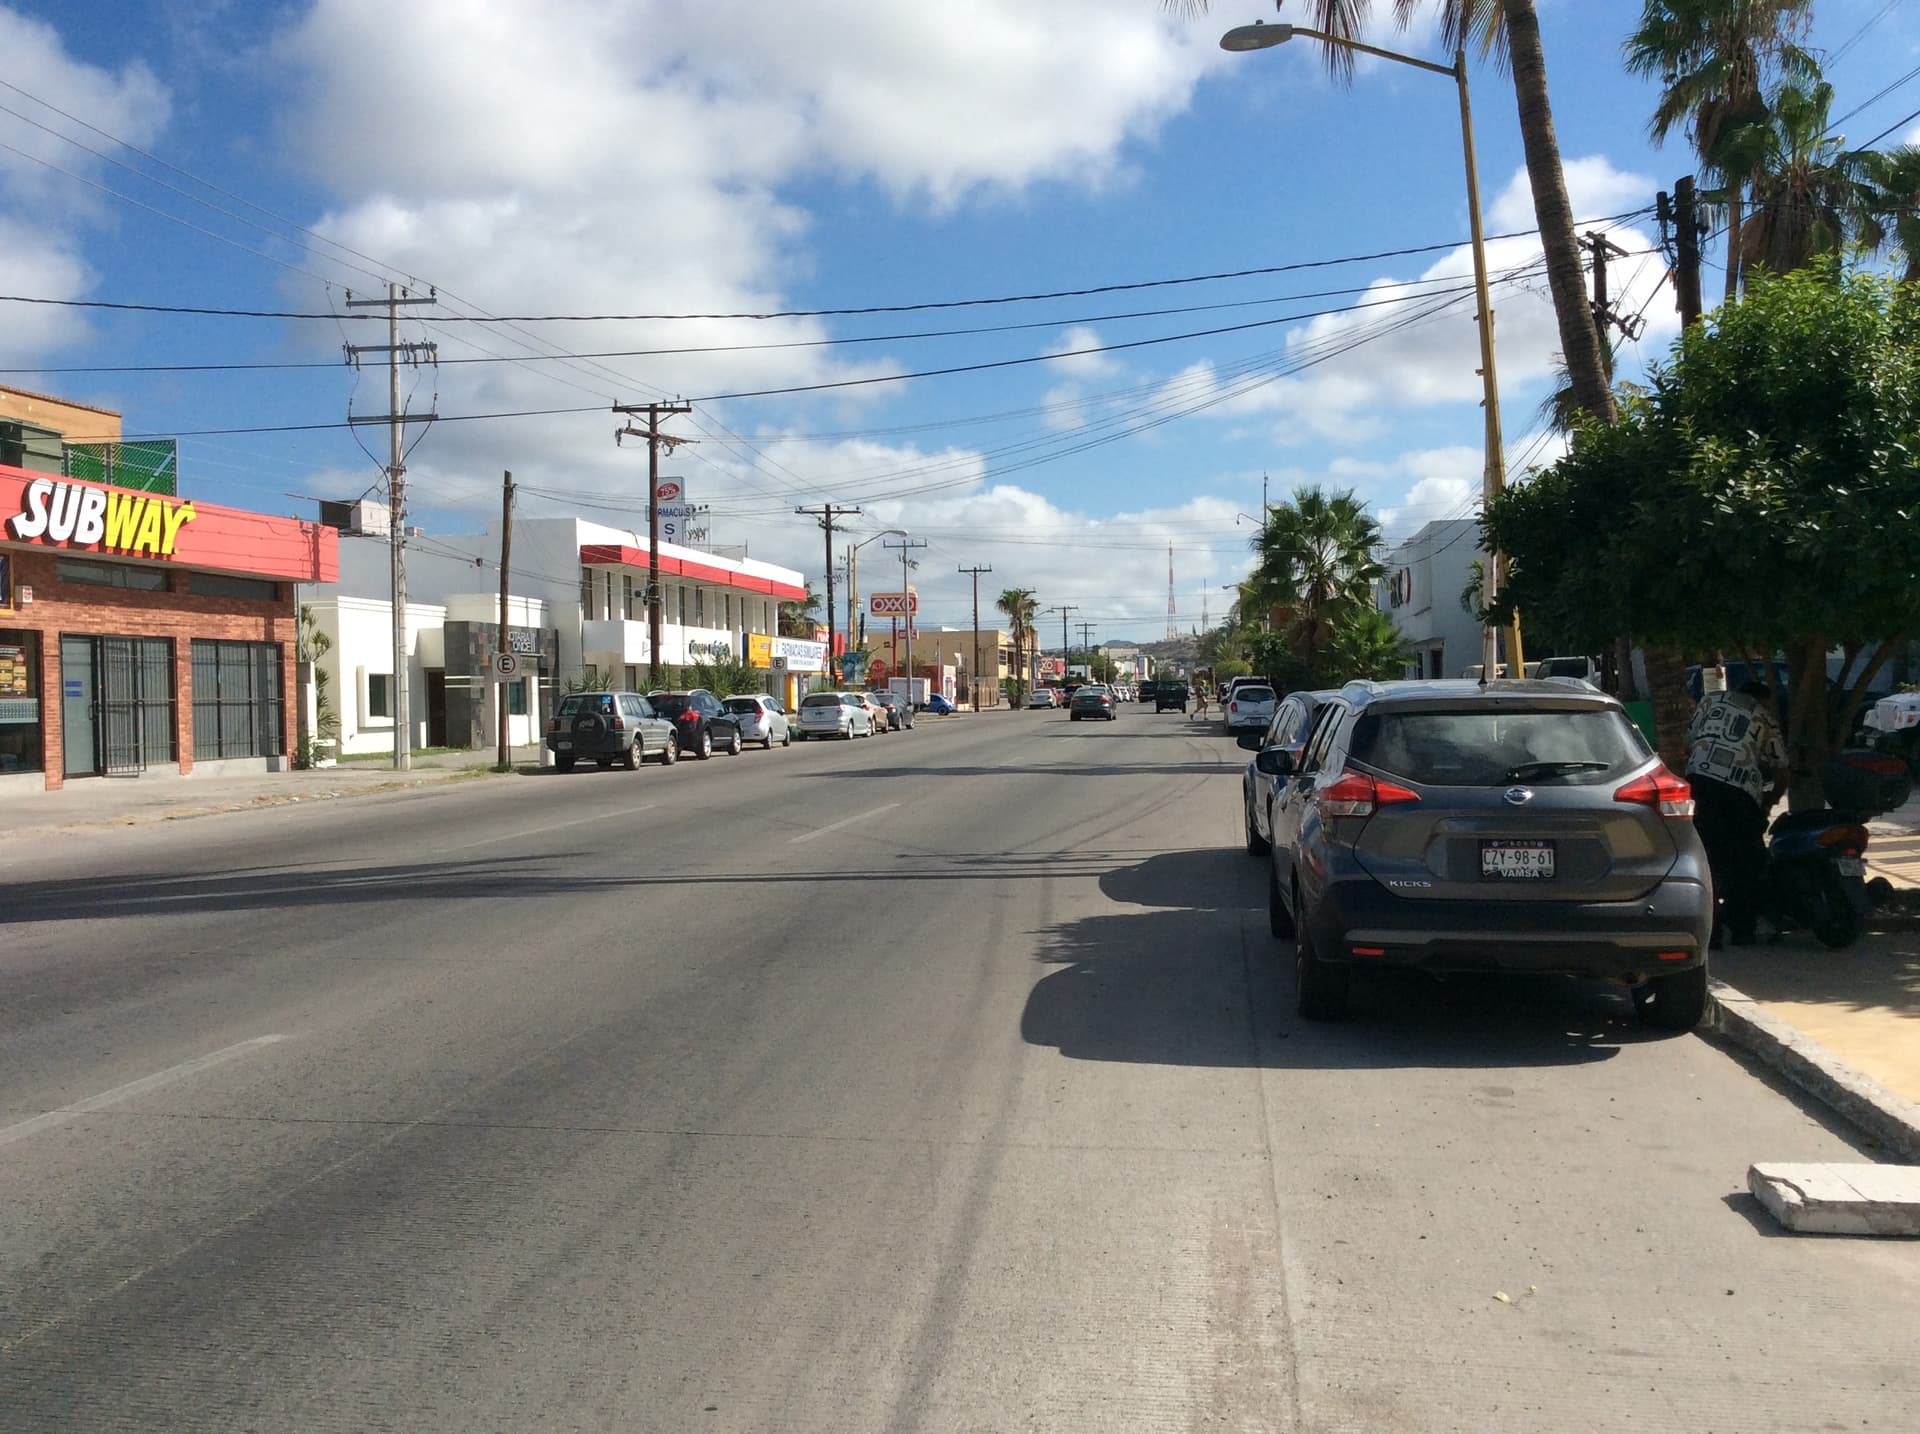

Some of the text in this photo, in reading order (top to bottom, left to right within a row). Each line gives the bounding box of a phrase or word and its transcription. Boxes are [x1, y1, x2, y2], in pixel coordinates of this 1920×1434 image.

[12, 478, 197, 555] SUBWAY
[872, 598, 915, 611] OXXO
[501, 657, 511, 671] E
[1483, 849, 1552, 866] CZY-98-61
[1500, 868, 1540, 878] VAMSA
[1389, 880, 1432, 888] KICKS
